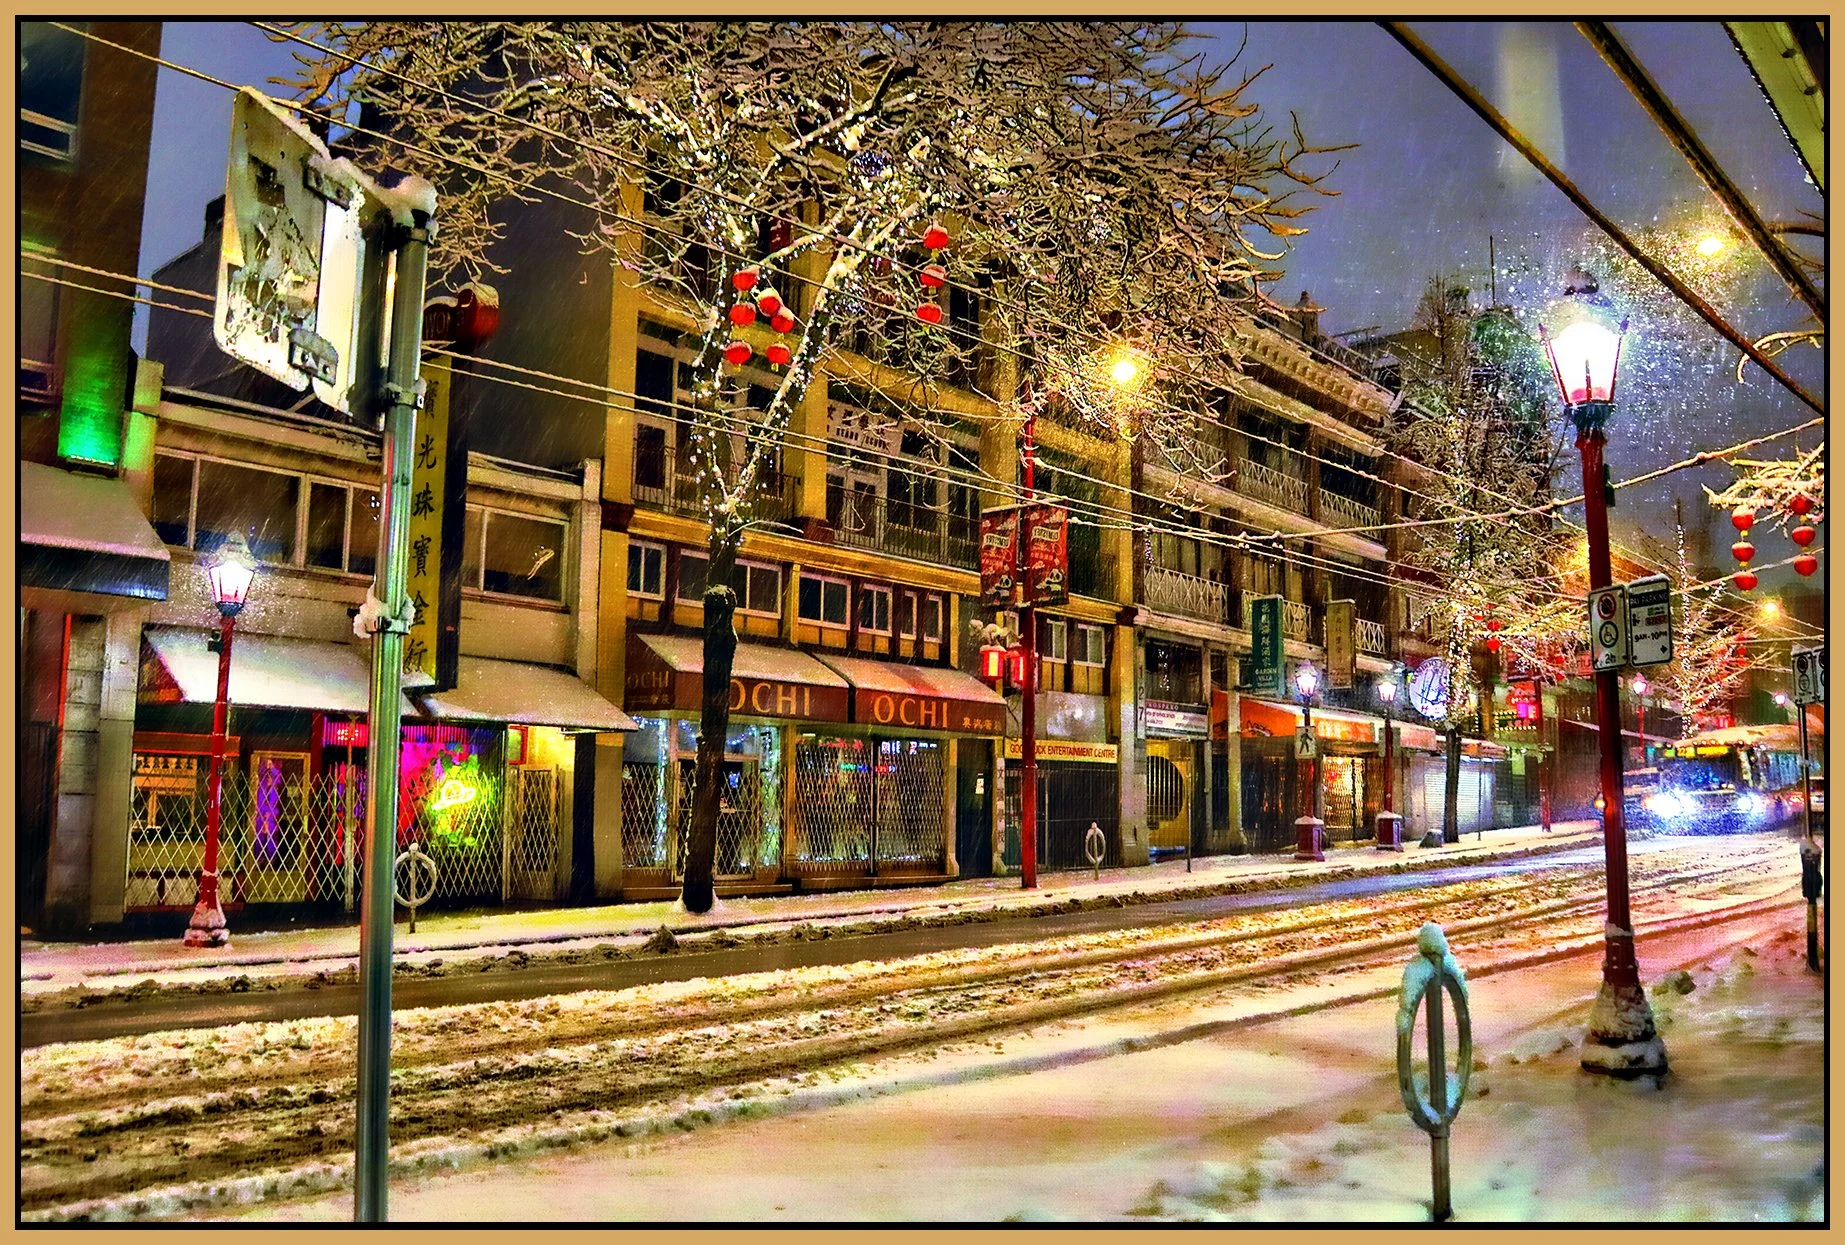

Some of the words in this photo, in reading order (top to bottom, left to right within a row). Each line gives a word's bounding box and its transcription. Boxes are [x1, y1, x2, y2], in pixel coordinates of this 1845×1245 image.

[627, 670, 669, 689] OCHI
[874, 694, 948, 728] OCHI
[1048, 745, 1094, 757] ENTERTAINMENT
[1094, 748, 1116, 759] CENTRE
